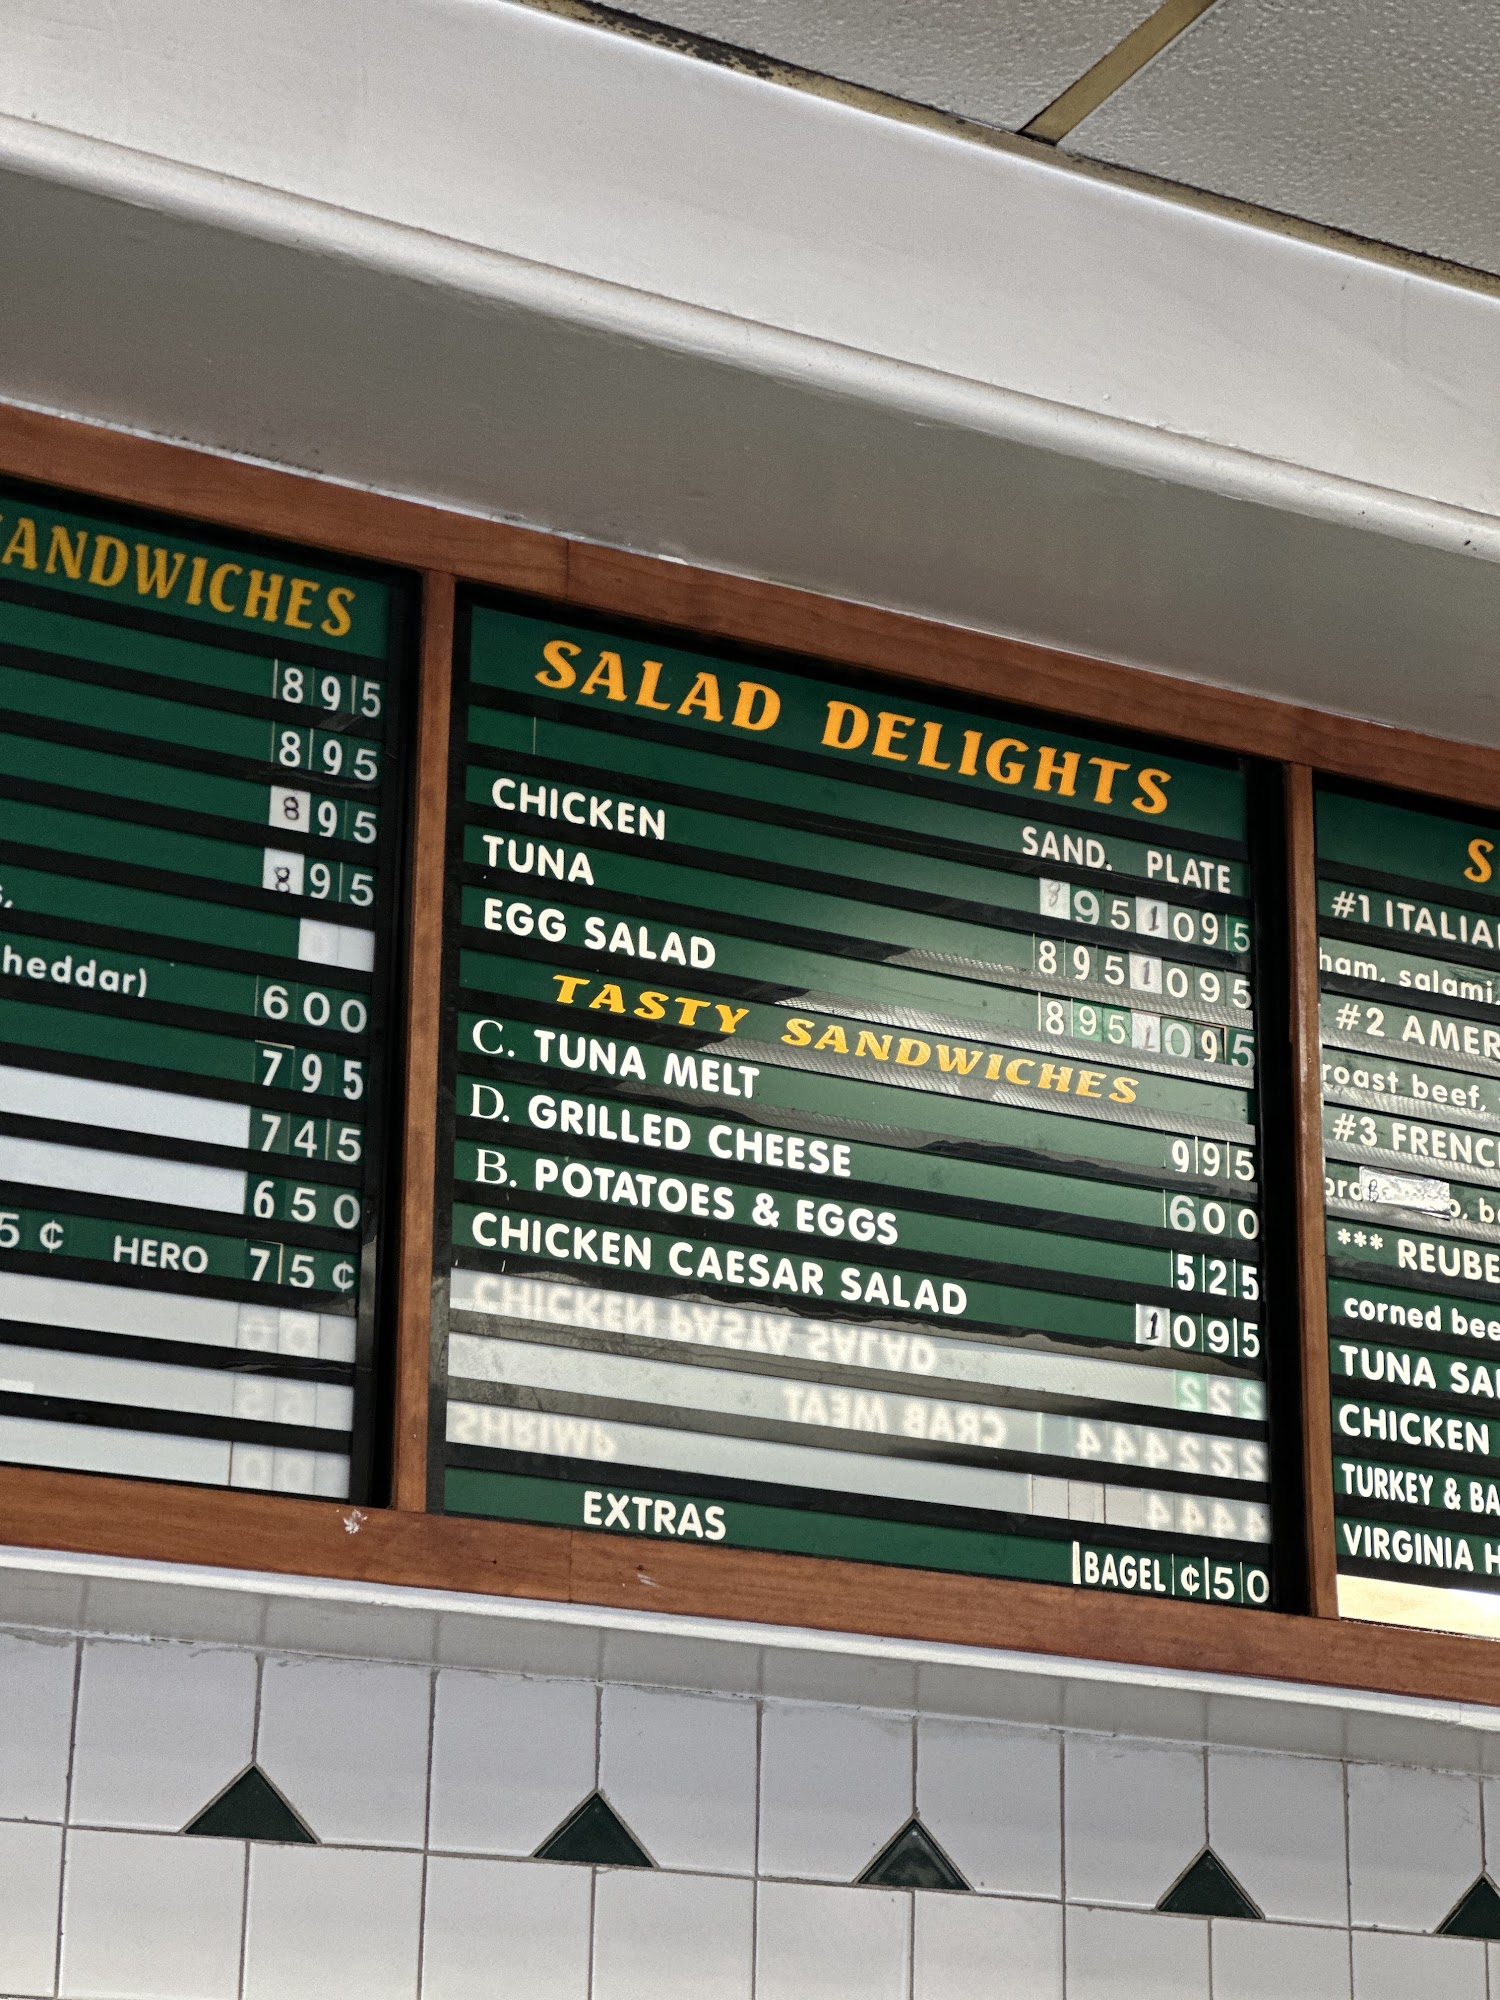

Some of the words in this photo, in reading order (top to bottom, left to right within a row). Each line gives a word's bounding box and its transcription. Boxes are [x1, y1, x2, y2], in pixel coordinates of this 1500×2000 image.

[0, 513, 356, 637] ANDWICHES
[534, 639, 782, 732] SALAD
[820, 700, 1172, 814] DELIGHTS
[491, 777, 666, 841] CHICKEN
[482, 834, 595, 886] TUNA
[1021, 825, 1113, 871] SAND.
[1147, 850, 1232, 894] PLATE
[483, 897, 567, 942] EGG
[583, 915, 716, 969] SALAD
[1331, 890, 1370, 924] #1
[1385, 899, 1500, 951] ITALIA
[552, 974, 750, 1034] TASTY
[781, 1017, 1140, 1104] SANDWICHES
[1336, 1002, 1386, 1037] #2
[472, 1019, 516, 1058] C.
[533, 1029, 647, 1081] TUNA
[663, 1052, 760, 1099] MELT
[1322, 1062, 1399, 1094] roast
[1412, 1073, 1487, 1112] beef,
[469, 1083, 510, 1123] D.
[527, 1094, 692, 1151] GRILLED
[708, 1124, 852, 1178] CHEESE
[1332, 1112, 1378, 1147] #3
[1391, 1121, 1500, 1169] FRENC
[474, 1148, 517, 1188] B.
[534, 1158, 735, 1221] POTATOES
[751, 1192, 780, 1228] &
[796, 1198, 899, 1246] EGGS
[113, 1235, 209, 1274] HERO
[471, 1211, 652, 1271] CHICKEN
[668, 1241, 825, 1297] CAESAR
[839, 1267, 968, 1315] SALAD
[1397, 1238, 1500, 1284] REUBE
[1343, 1297, 1442, 1333] corned
[1338, 1344, 1437, 1390] TUNA
[1449, 1361, 1500, 1400] SA
[1338, 1403, 1490, 1455] CHICKEN
[1341, 1462, 1434, 1506] TURKEY
[1443, 1477, 1462, 1511] &
[583, 1490, 727, 1541] EXTRAS
[1084, 1550, 1167, 1592] BAGEL
[1342, 1522, 1475, 1572] VIRGINIA
